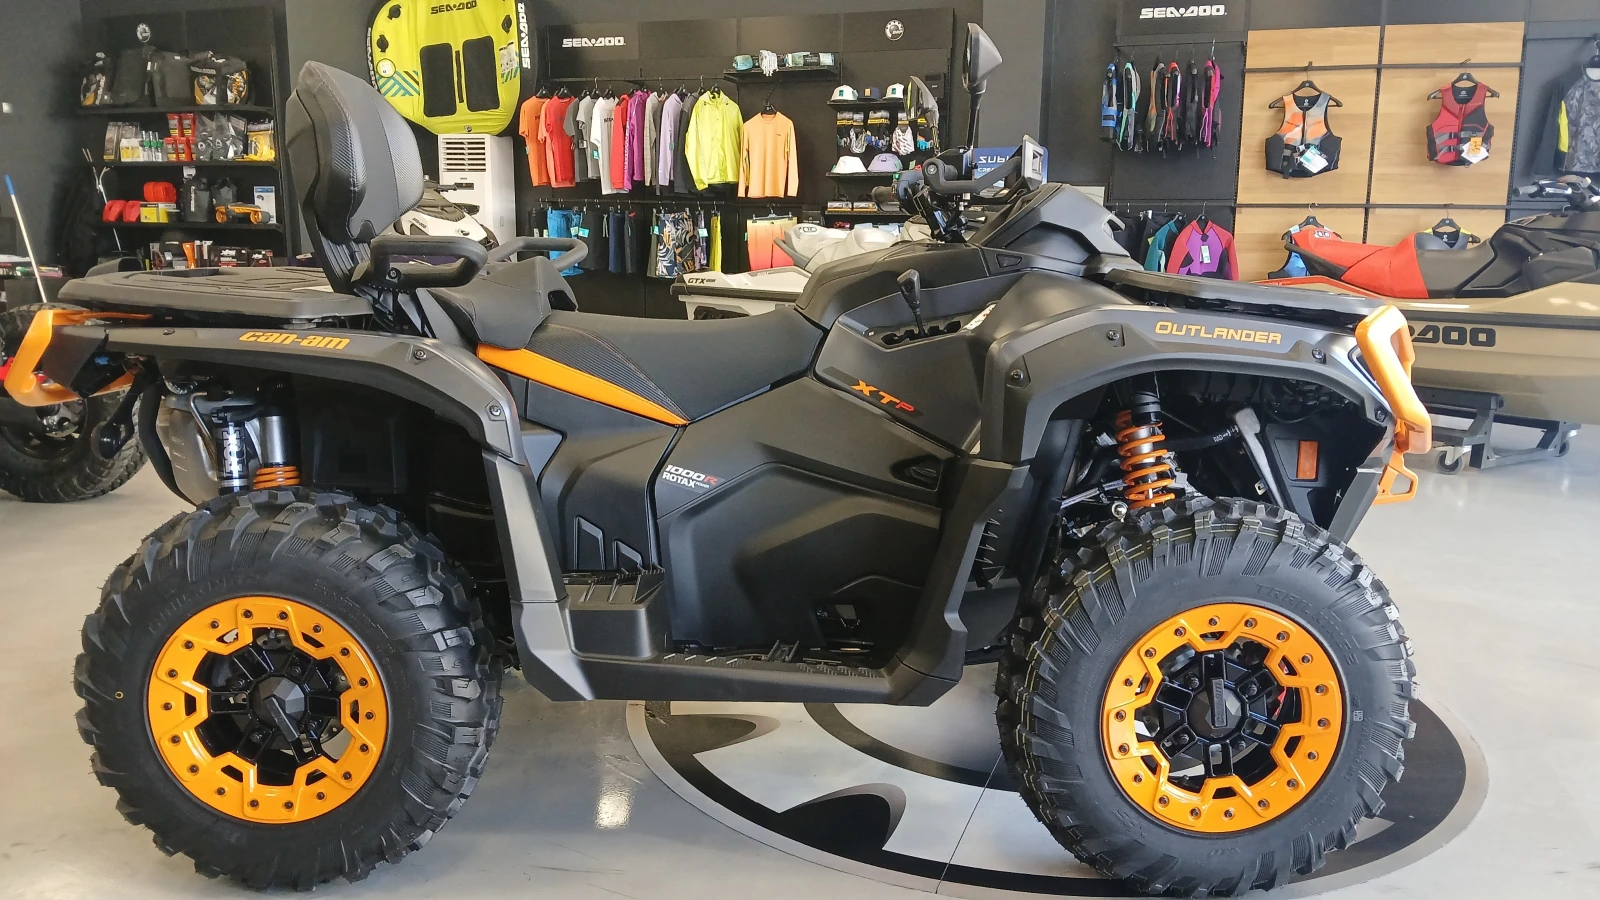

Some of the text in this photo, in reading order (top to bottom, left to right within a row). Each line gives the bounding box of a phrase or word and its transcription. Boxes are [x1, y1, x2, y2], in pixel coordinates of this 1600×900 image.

[687, 277, 706, 285] GTX
[239, 331, 350, 350] can-am
[1155, 320, 1282, 345] OUTLANDER
[662, 471, 696, 489] ROTAX
[665, 464, 719, 486] 1000R
